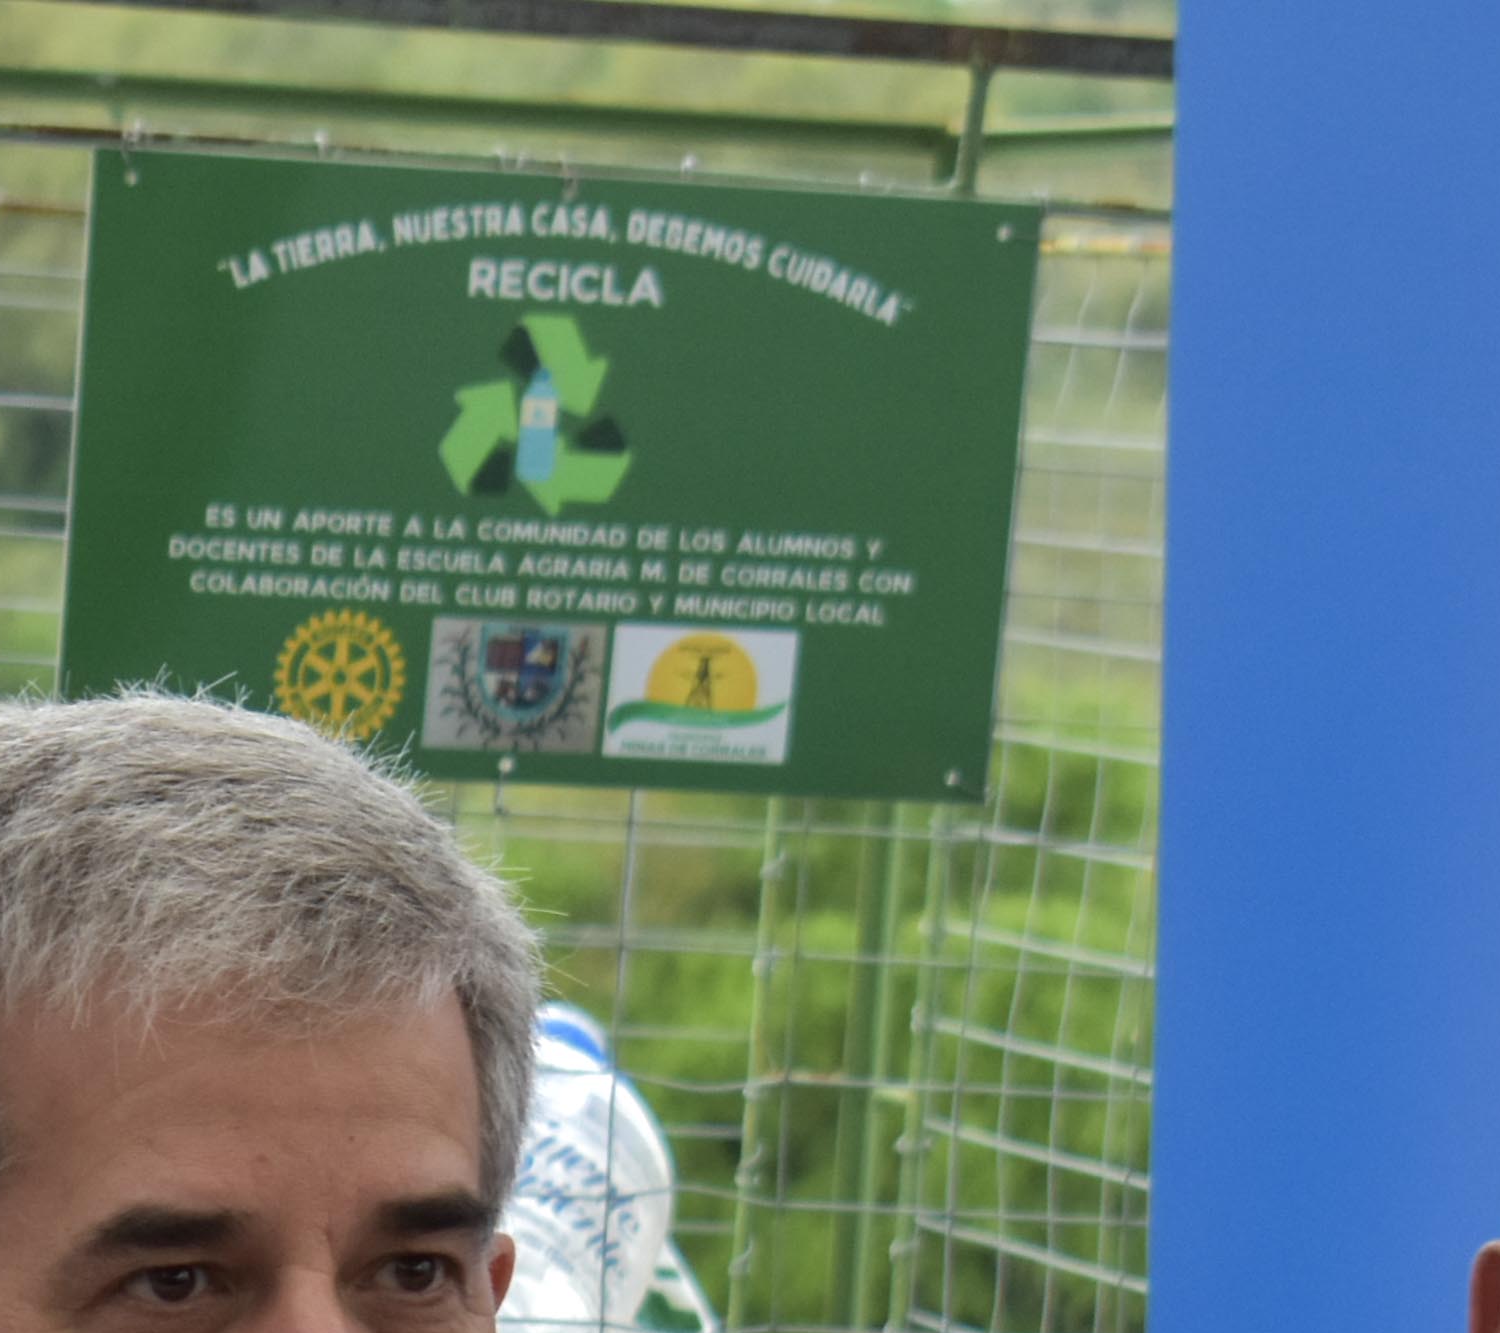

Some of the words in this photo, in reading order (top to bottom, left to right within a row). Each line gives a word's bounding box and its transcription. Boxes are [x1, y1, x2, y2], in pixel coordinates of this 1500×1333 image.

[271, 217, 388, 275] TIERRA,
[391, 200, 524, 248] NUESTRA
[530, 200, 617, 244] CASA,
[626, 208, 766, 271] DEBEMOS
[468, 257, 664, 309] RECICLA
[205, 504, 236, 530] ES
[246, 507, 282, 532] UN
[292, 508, 393, 538] APORTE
[403, 514, 423, 538] A
[433, 517, 466, 541] LA
[477, 519, 627, 550] COMUNIDAD
[636, 524, 670, 551] DE
[678, 529, 727, 554] LOS
[736, 532, 856, 561] ALUMNOS
[866, 537, 884, 561] Y
[168, 534, 301, 566] DOCENTES
[310, 541, 344, 568] DE
[353, 544, 386, 569] LA
[396, 547, 506, 576] ESCUELA
[517, 551, 630, 581] AGRARIA
[678, 560, 711, 586] DE
[720, 564, 849, 594] CORRALES
[857, 569, 914, 596] CON
[189, 568, 393, 601] COLABORACIÓN
[400, 579, 444, 605] DEL
[454, 581, 517, 609] CLUB
[527, 583, 637, 614] ROTARIO
[648, 590, 667, 614] Y
[673, 592, 796, 622] MUNICIPIO
[804, 600, 887, 626] LOCAL
